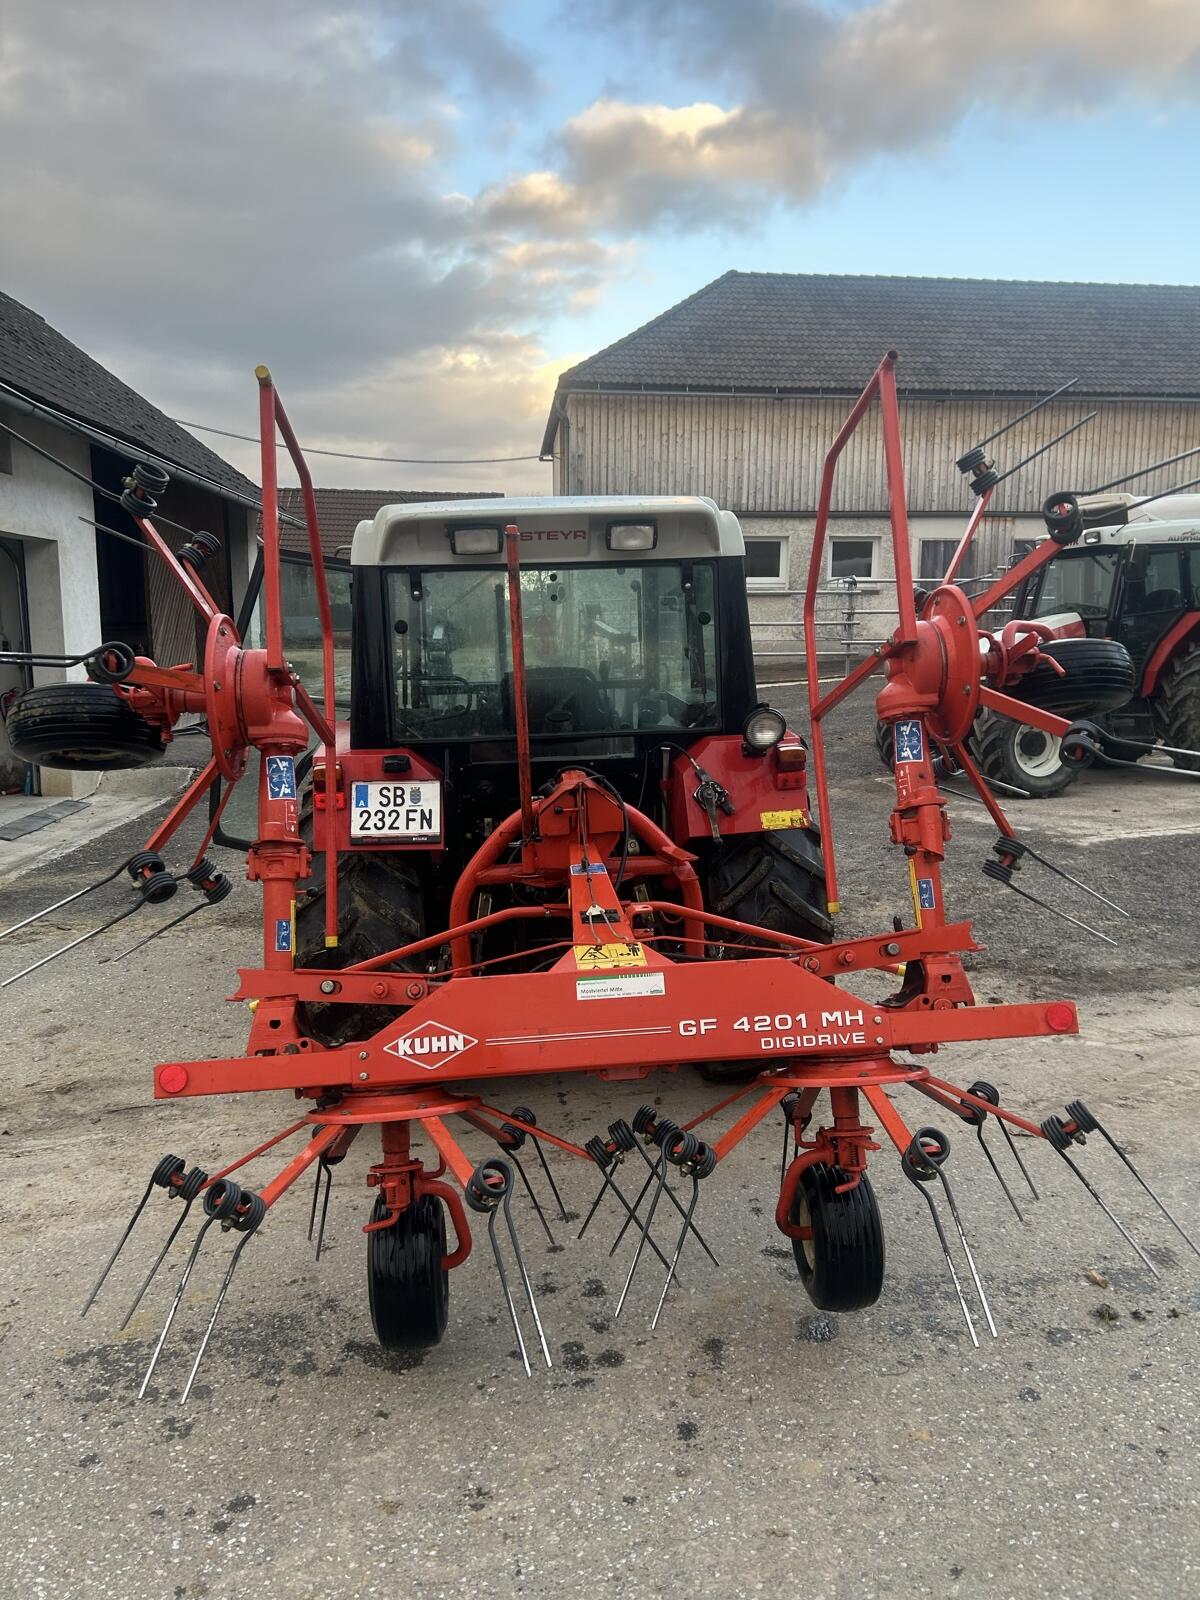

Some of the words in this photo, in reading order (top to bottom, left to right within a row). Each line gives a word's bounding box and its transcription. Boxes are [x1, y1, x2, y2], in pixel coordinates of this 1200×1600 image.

[520, 530, 586, 541] STEYR
[379, 786, 405, 807] SB
[359, 809, 400, 830] 232
[405, 808, 432, 830] FN
[679, 1018, 717, 1036] GF
[733, 1013, 807, 1032] 4201
[821, 1009, 864, 1028] MH
[398, 1033, 464, 1056] KUHN
[761, 1032, 866, 1049] DIGIDRIVE
